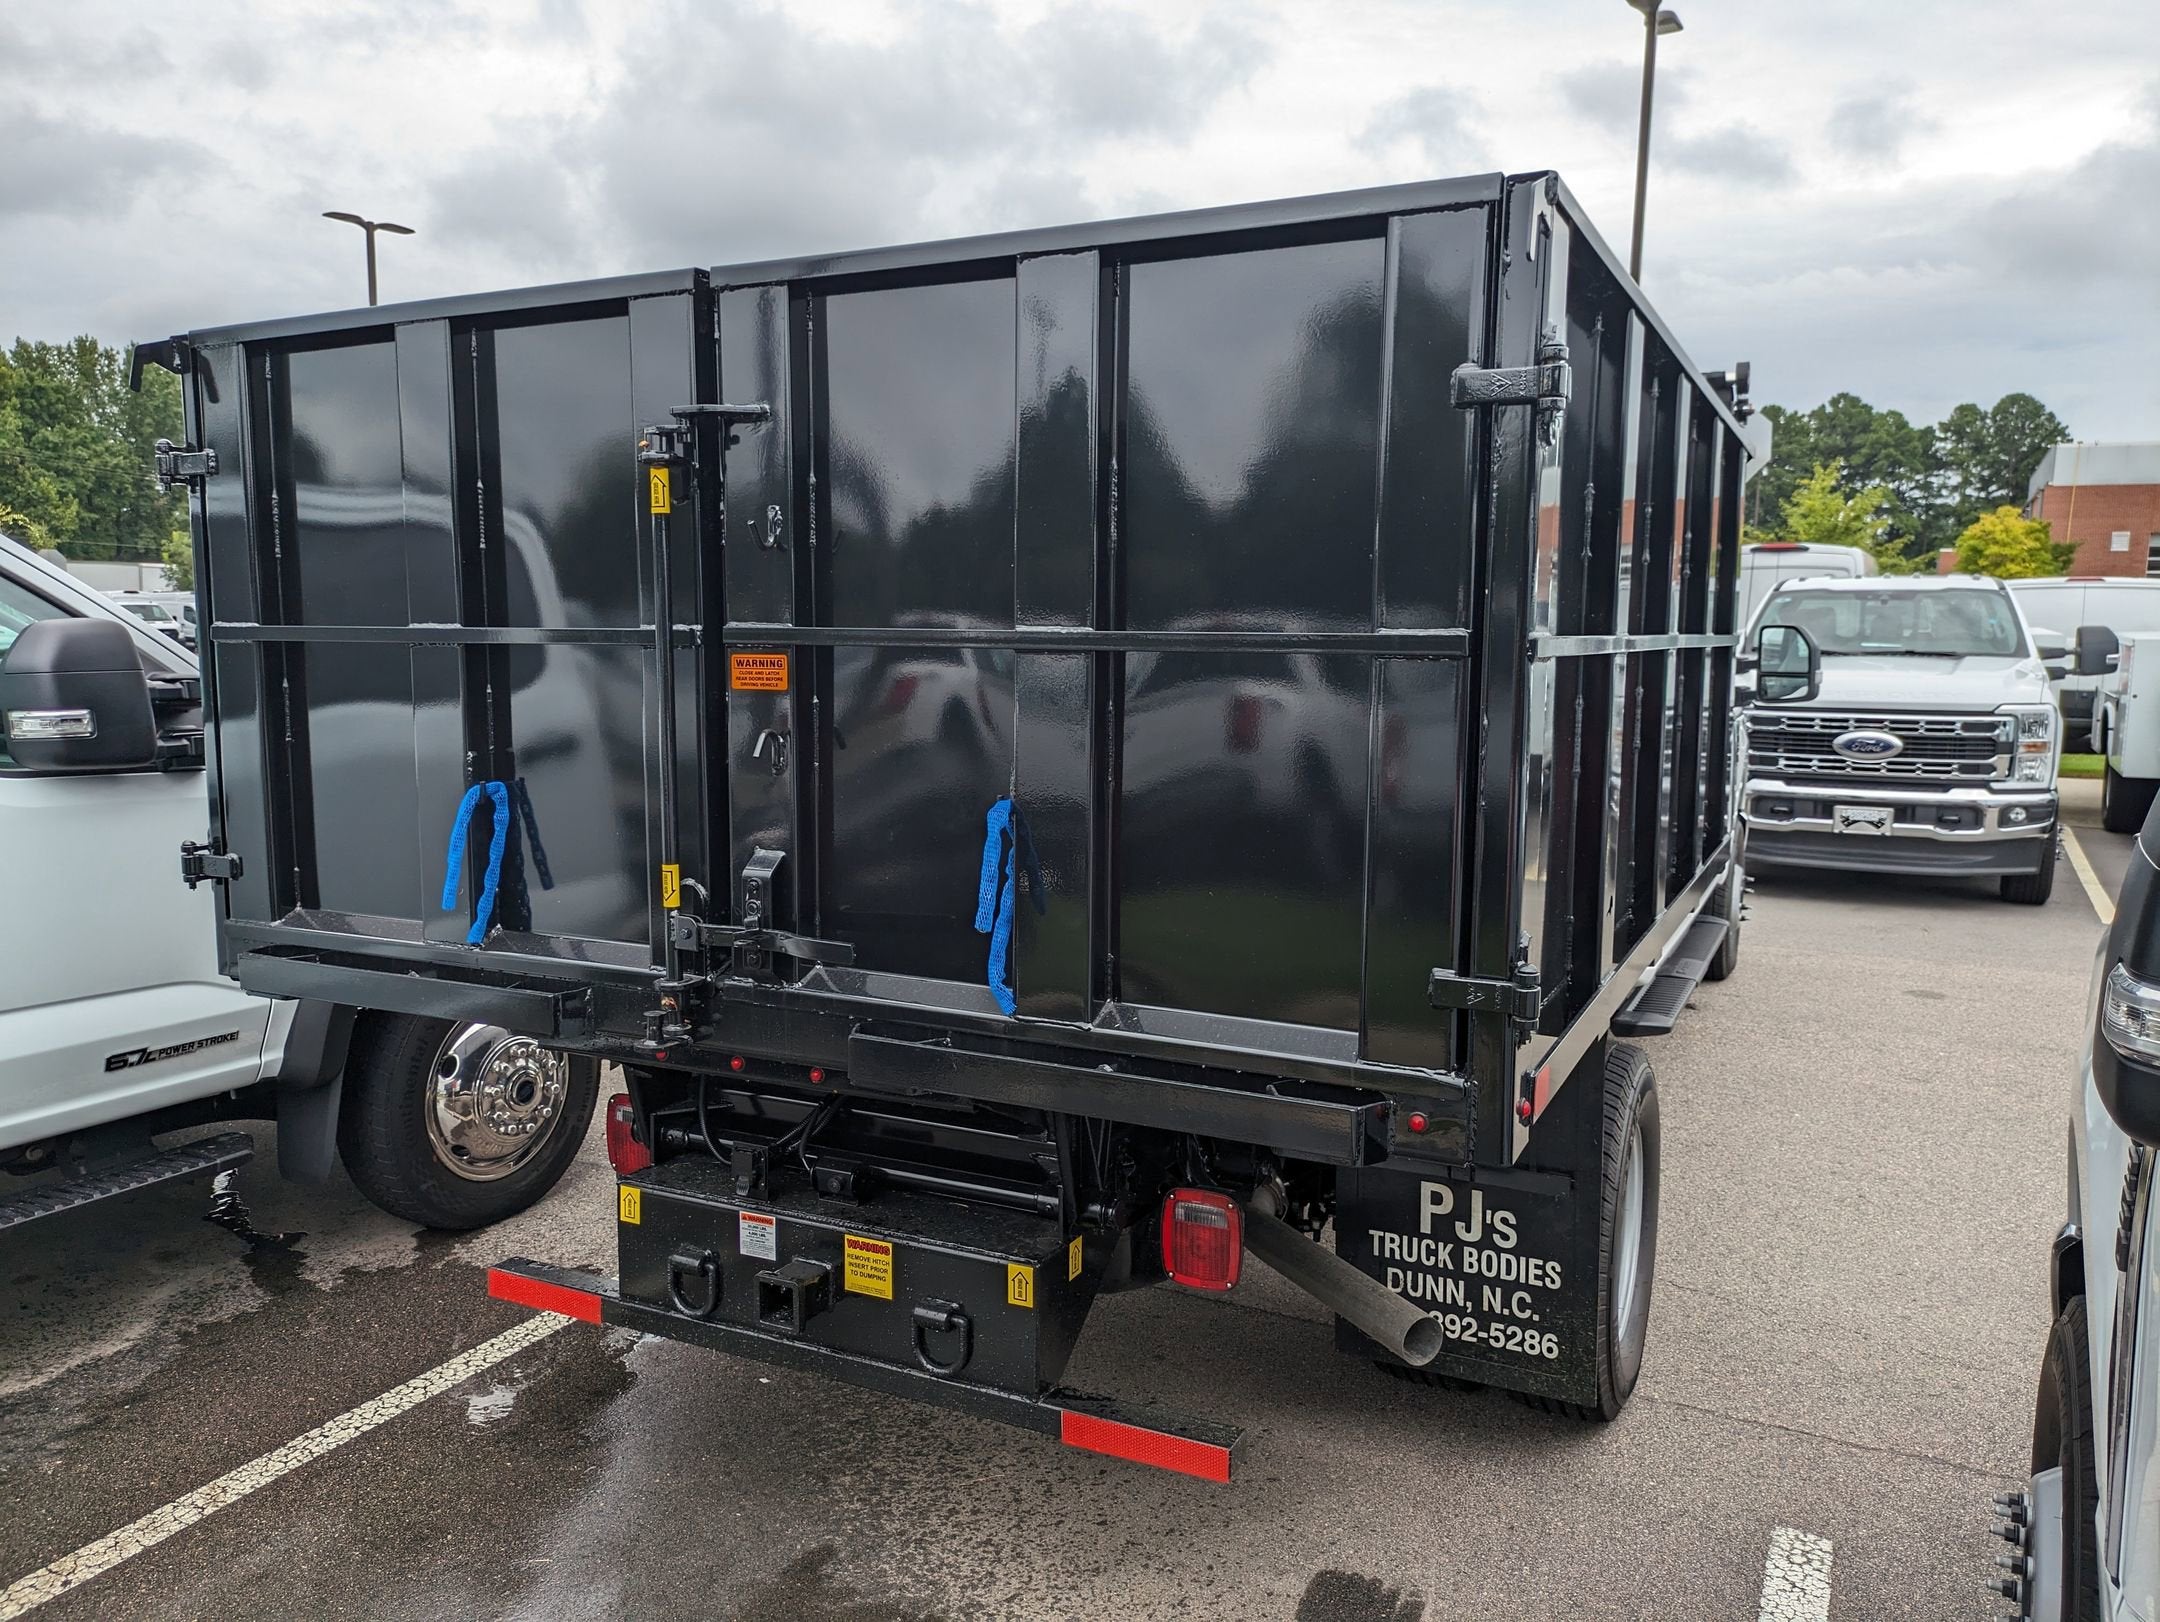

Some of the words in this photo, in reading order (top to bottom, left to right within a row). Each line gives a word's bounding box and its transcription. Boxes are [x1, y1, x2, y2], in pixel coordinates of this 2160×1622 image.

[736, 659, 783, 668] WARNING
[104, 1047, 157, 1072] 6.7L
[159, 1041, 196, 1057] POWER
[197, 1031, 236, 1048] STROKE
[748, 1214, 773, 1226] WARNING
[1419, 1180, 1518, 1249] PJ'S
[847, 1238, 890, 1256] WARNING
[847, 1253, 871, 1263] REMOVE
[872, 1258, 889, 1266] HITCH
[1368, 1229, 1455, 1270] TRUCK
[1463, 1246, 1562, 1290] BODIES
[848, 1261, 869, 1270] INSERT
[870, 1265, 888, 1274] PRIOR
[859, 1271, 887, 1282] DUMPING
[1387, 1267, 1473, 1313] DUNN,
[1482, 1285, 1540, 1321] N.C.
